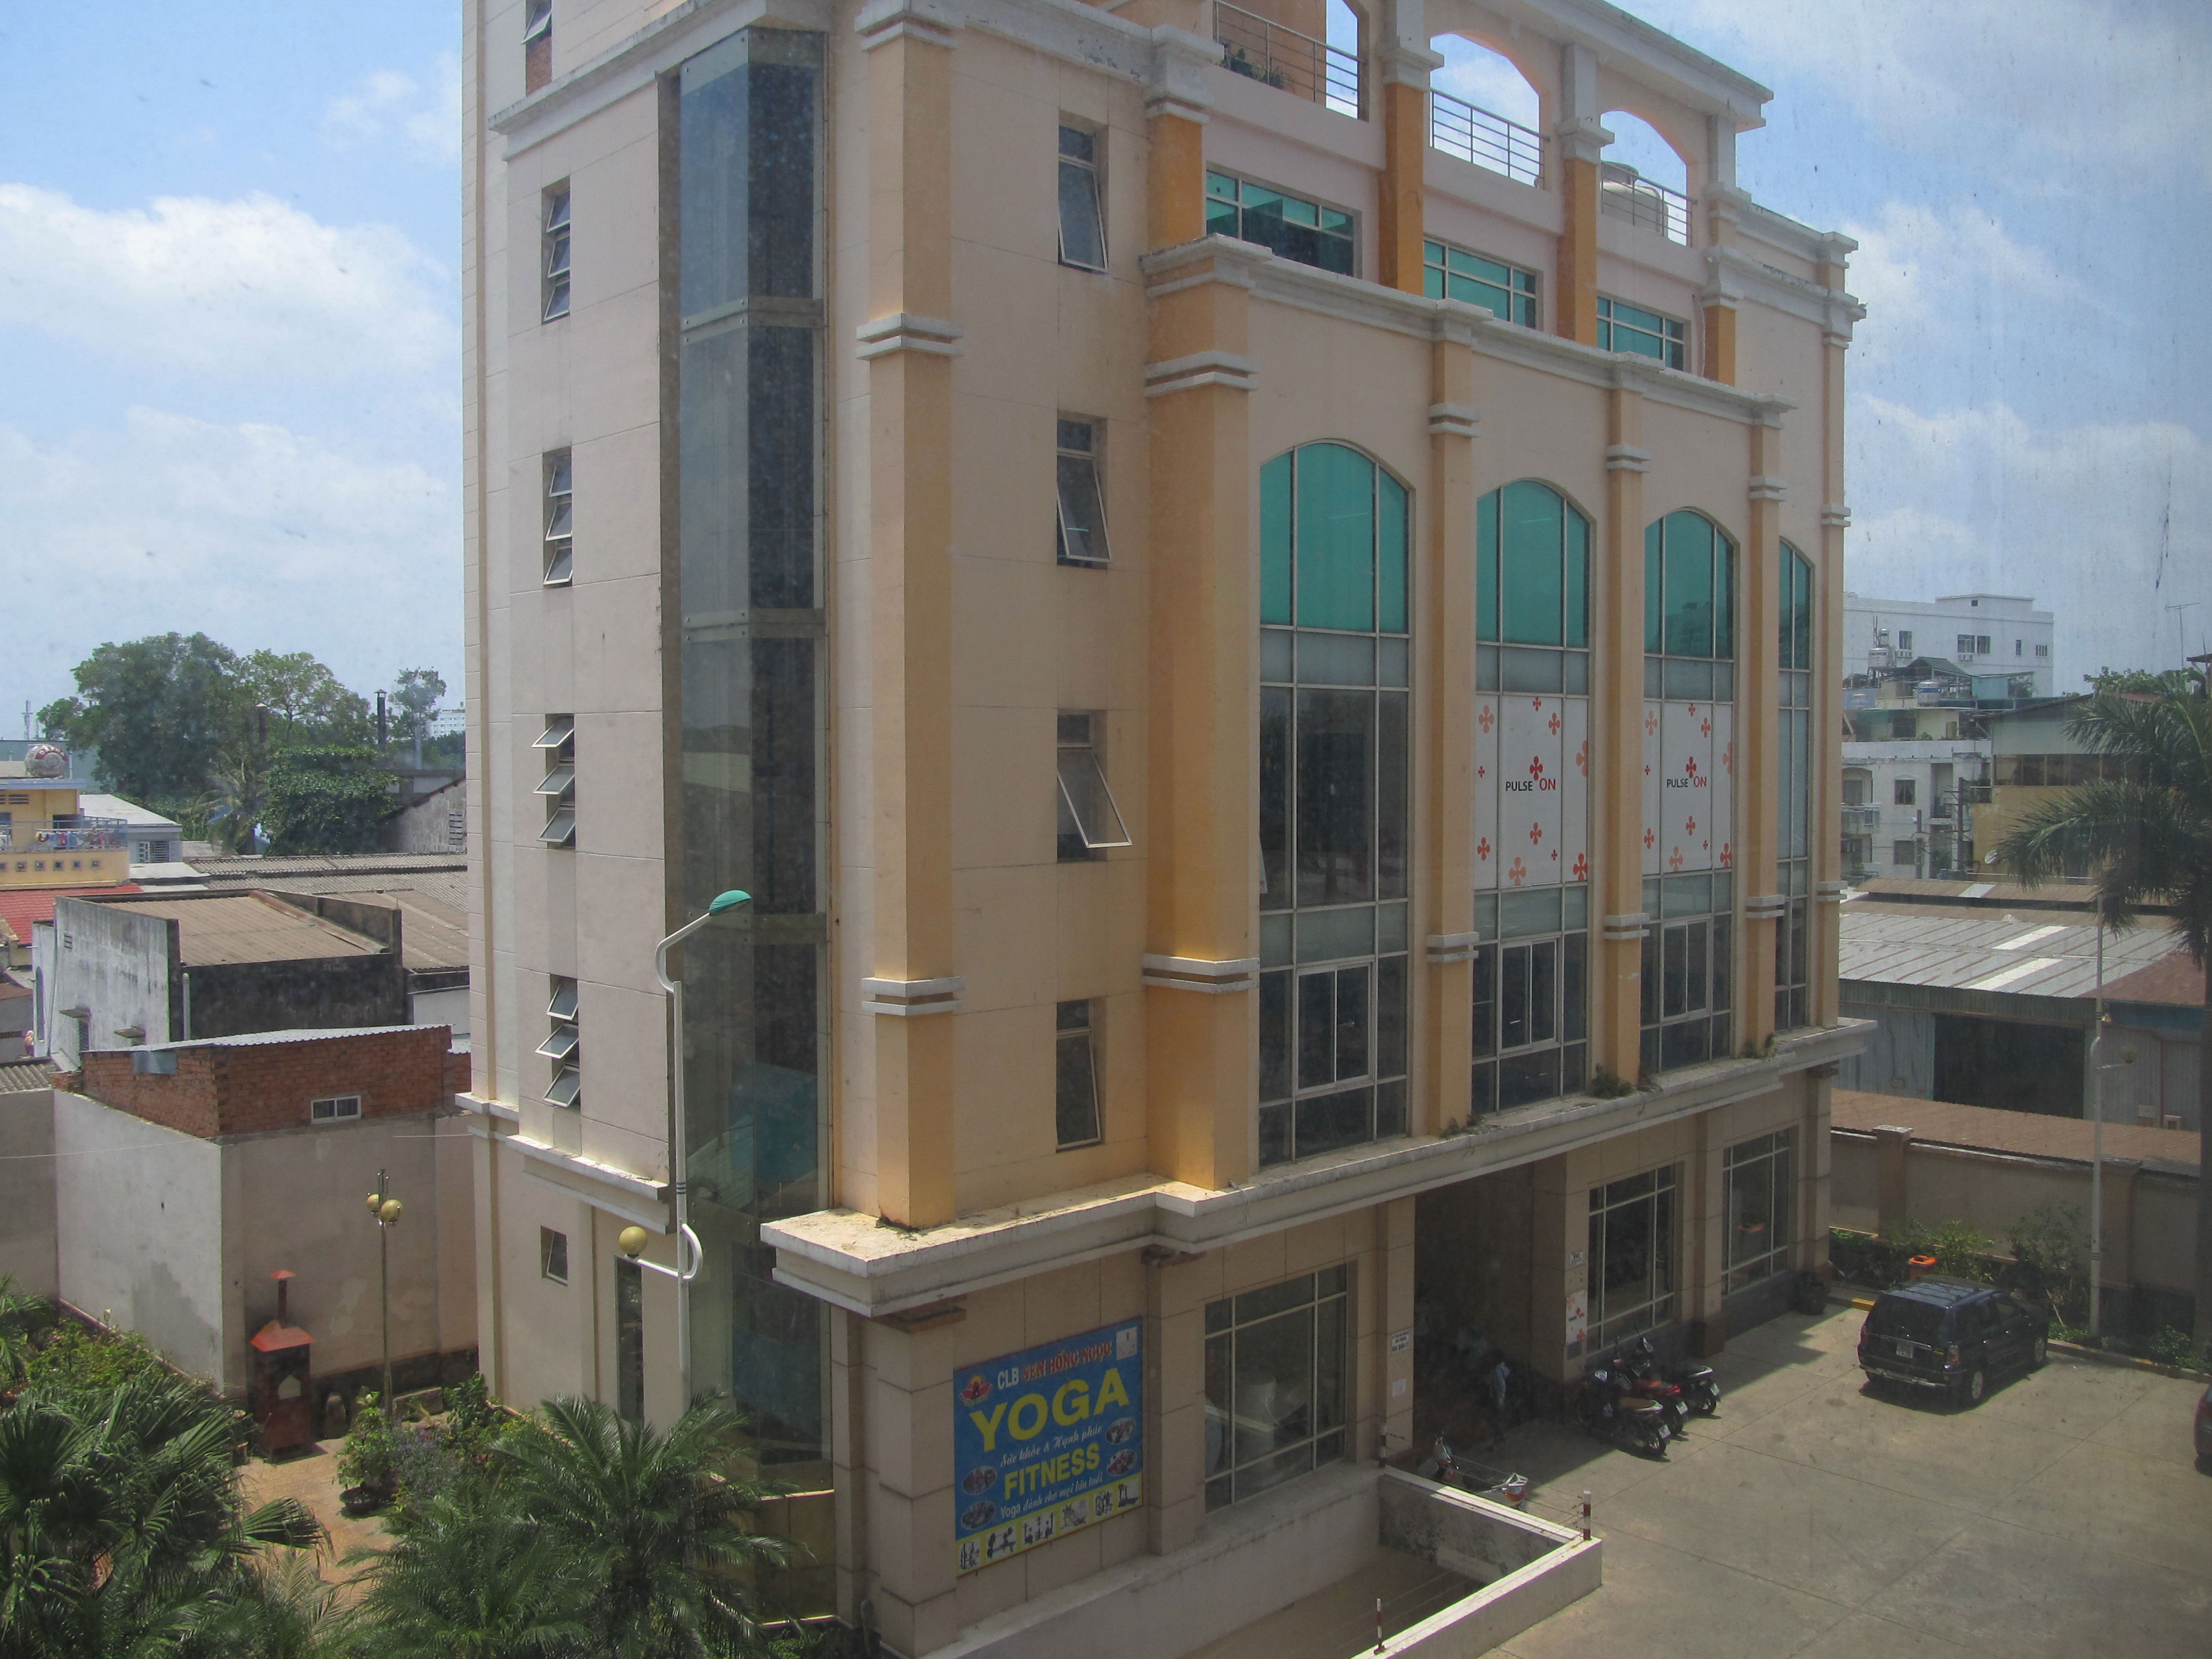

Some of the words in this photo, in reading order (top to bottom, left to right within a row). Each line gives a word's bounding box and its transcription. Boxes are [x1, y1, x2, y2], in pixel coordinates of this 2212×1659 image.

[1505, 780, 1533, 791] PULSE
[1539, 778, 1557, 791] ON
[1666, 778, 1688, 789] PULSE
[1693, 776, 1707, 787] ON
[997, 1367, 1019, 1390] CLB
[969, 1368, 1130, 1452] YOGA
[1004, 1443, 1100, 1500] FITNESS
[1000, 1504, 1021, 1519] Yoga
[1022, 1495, 1042, 1511] dành
[1044, 1490, 1058, 1503] cho
[1059, 1483, 1074, 1498] mọi
